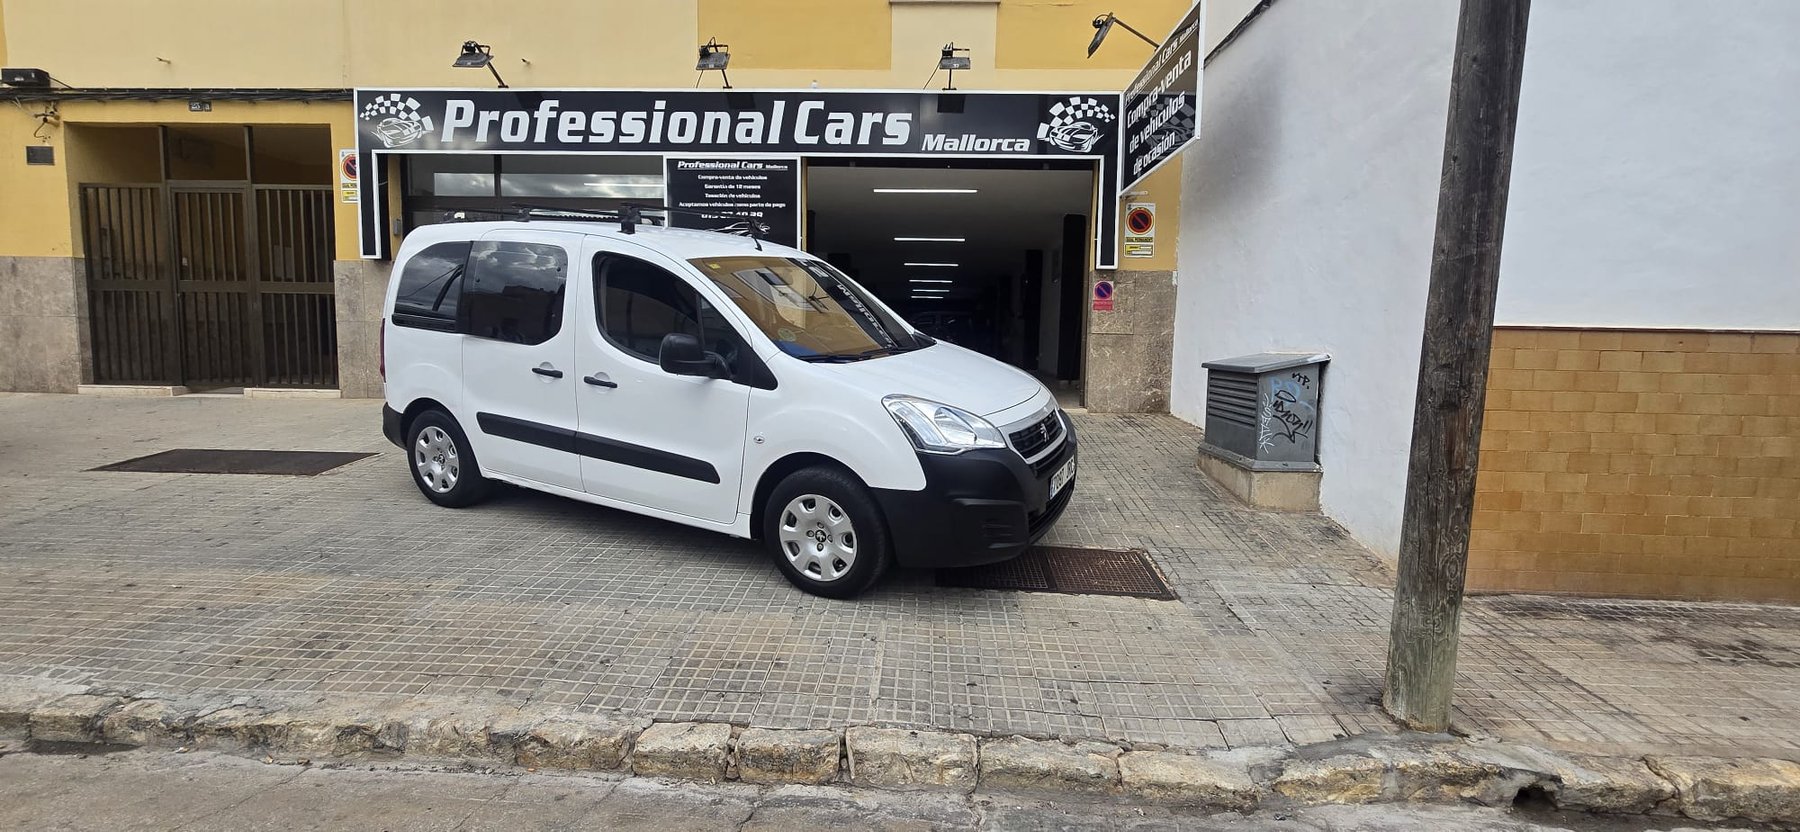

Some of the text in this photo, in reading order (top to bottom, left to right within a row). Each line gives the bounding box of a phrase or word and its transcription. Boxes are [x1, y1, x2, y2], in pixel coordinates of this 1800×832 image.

[1125, 55, 1161, 105] Professional
[1161, 38, 1178, 64] Cars
[1127, 50, 1191, 128] Compra-venta
[441, 100, 1031, 152] Professional Cars Mallorca
[1129, 134, 1139, 153] de
[678, 161, 740, 169] Professional
[741, 161, 763, 169] Cars
[1133, 131, 1175, 175] de ocasión
